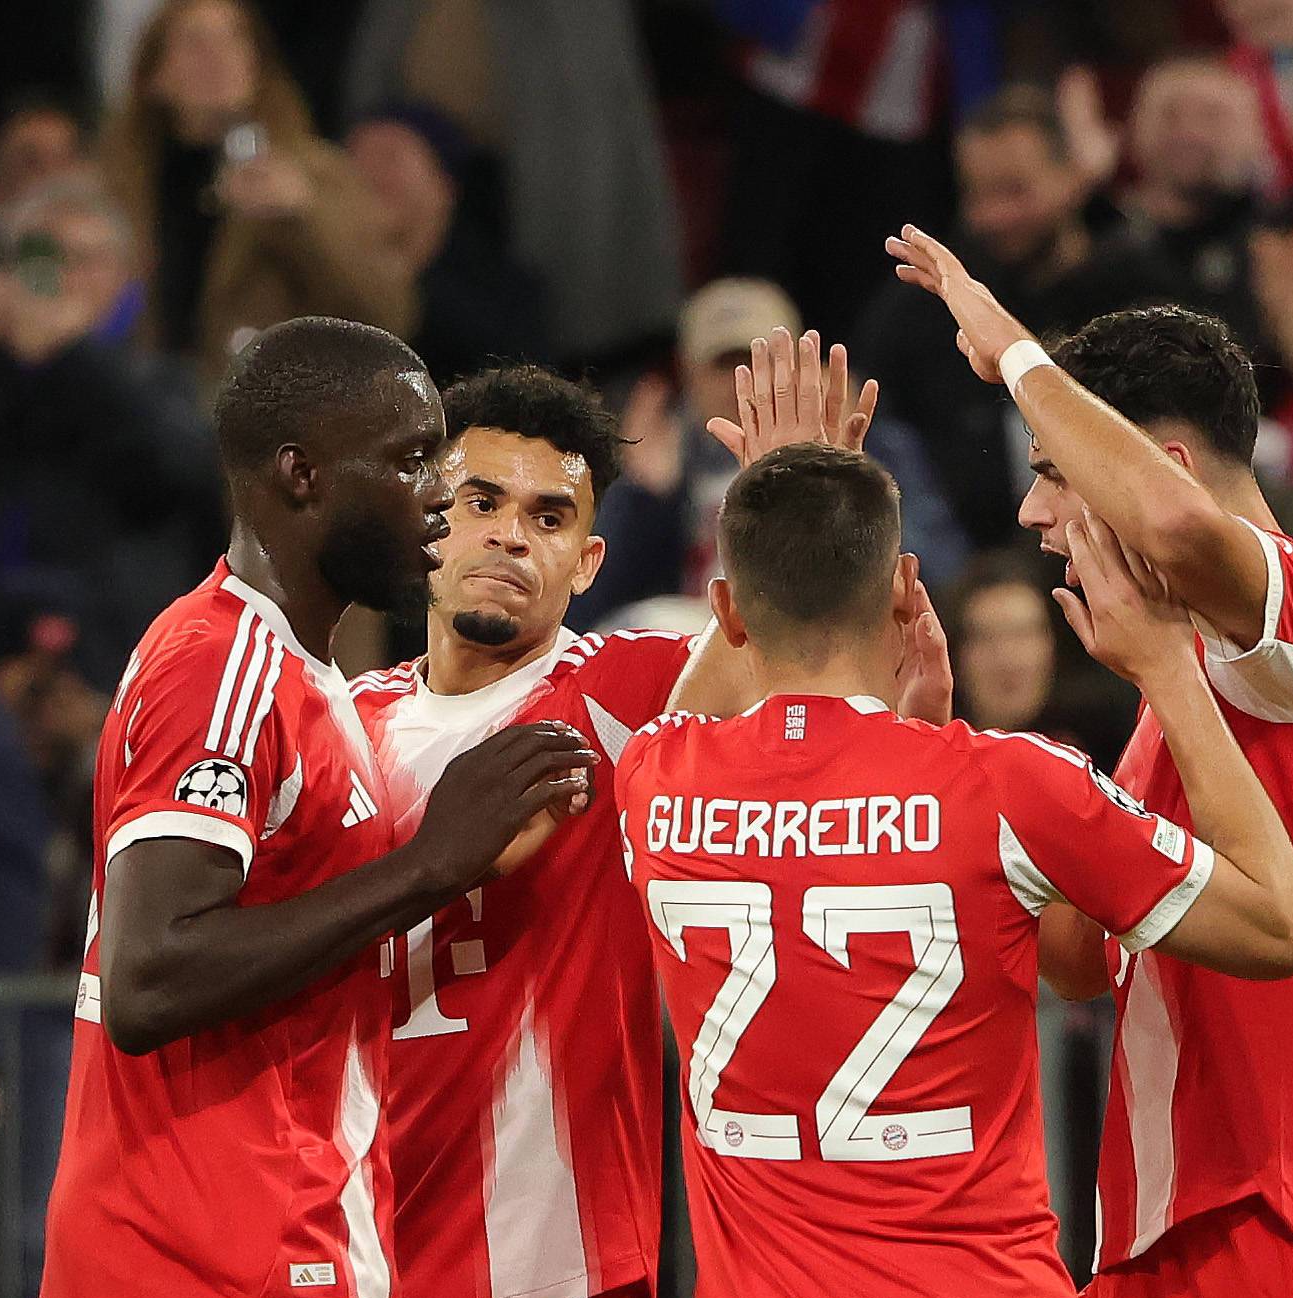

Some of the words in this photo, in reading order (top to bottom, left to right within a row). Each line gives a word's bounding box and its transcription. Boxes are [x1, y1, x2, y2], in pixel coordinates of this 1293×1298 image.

[787, 704, 806, 717] MIA
[784, 728, 805, 740] MIA
[647, 794, 940, 858] GUERREIRO
[646, 879, 975, 1162] 22
